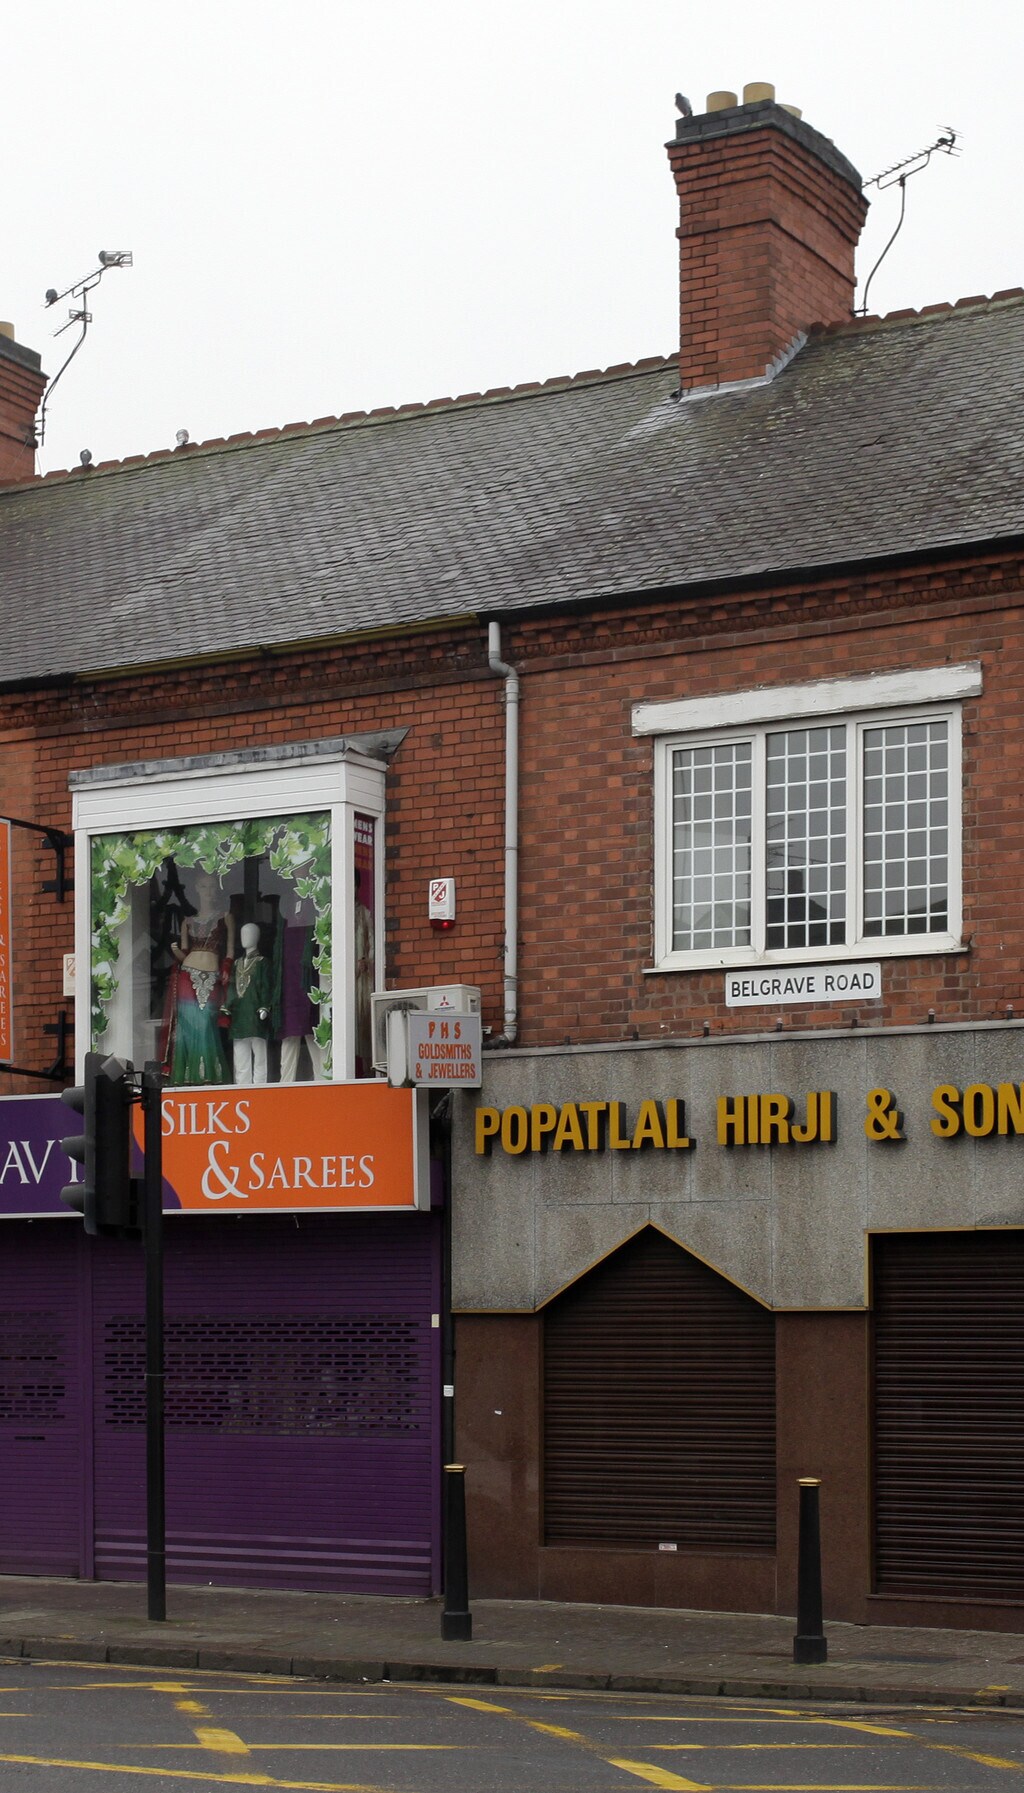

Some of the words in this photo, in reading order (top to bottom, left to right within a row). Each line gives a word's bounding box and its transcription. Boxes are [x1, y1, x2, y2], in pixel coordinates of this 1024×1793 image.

[731, 976, 816, 998] BELGRAVE
[824, 972, 875, 992] ROAD
[418, 1043, 472, 1060] GOLDSMITHS
[415, 1062, 422, 1079] &
[428, 1062, 476, 1079] JEWELLERS
[162, 1099, 251, 1136] SILKS
[475, 1098, 691, 1155] POPATLAL
[717, 1091, 834, 1145] HIRJI
[864, 1087, 902, 1141] &
[201, 1140, 249, 1200] &
[248, 1152, 374, 1190] SAREES
